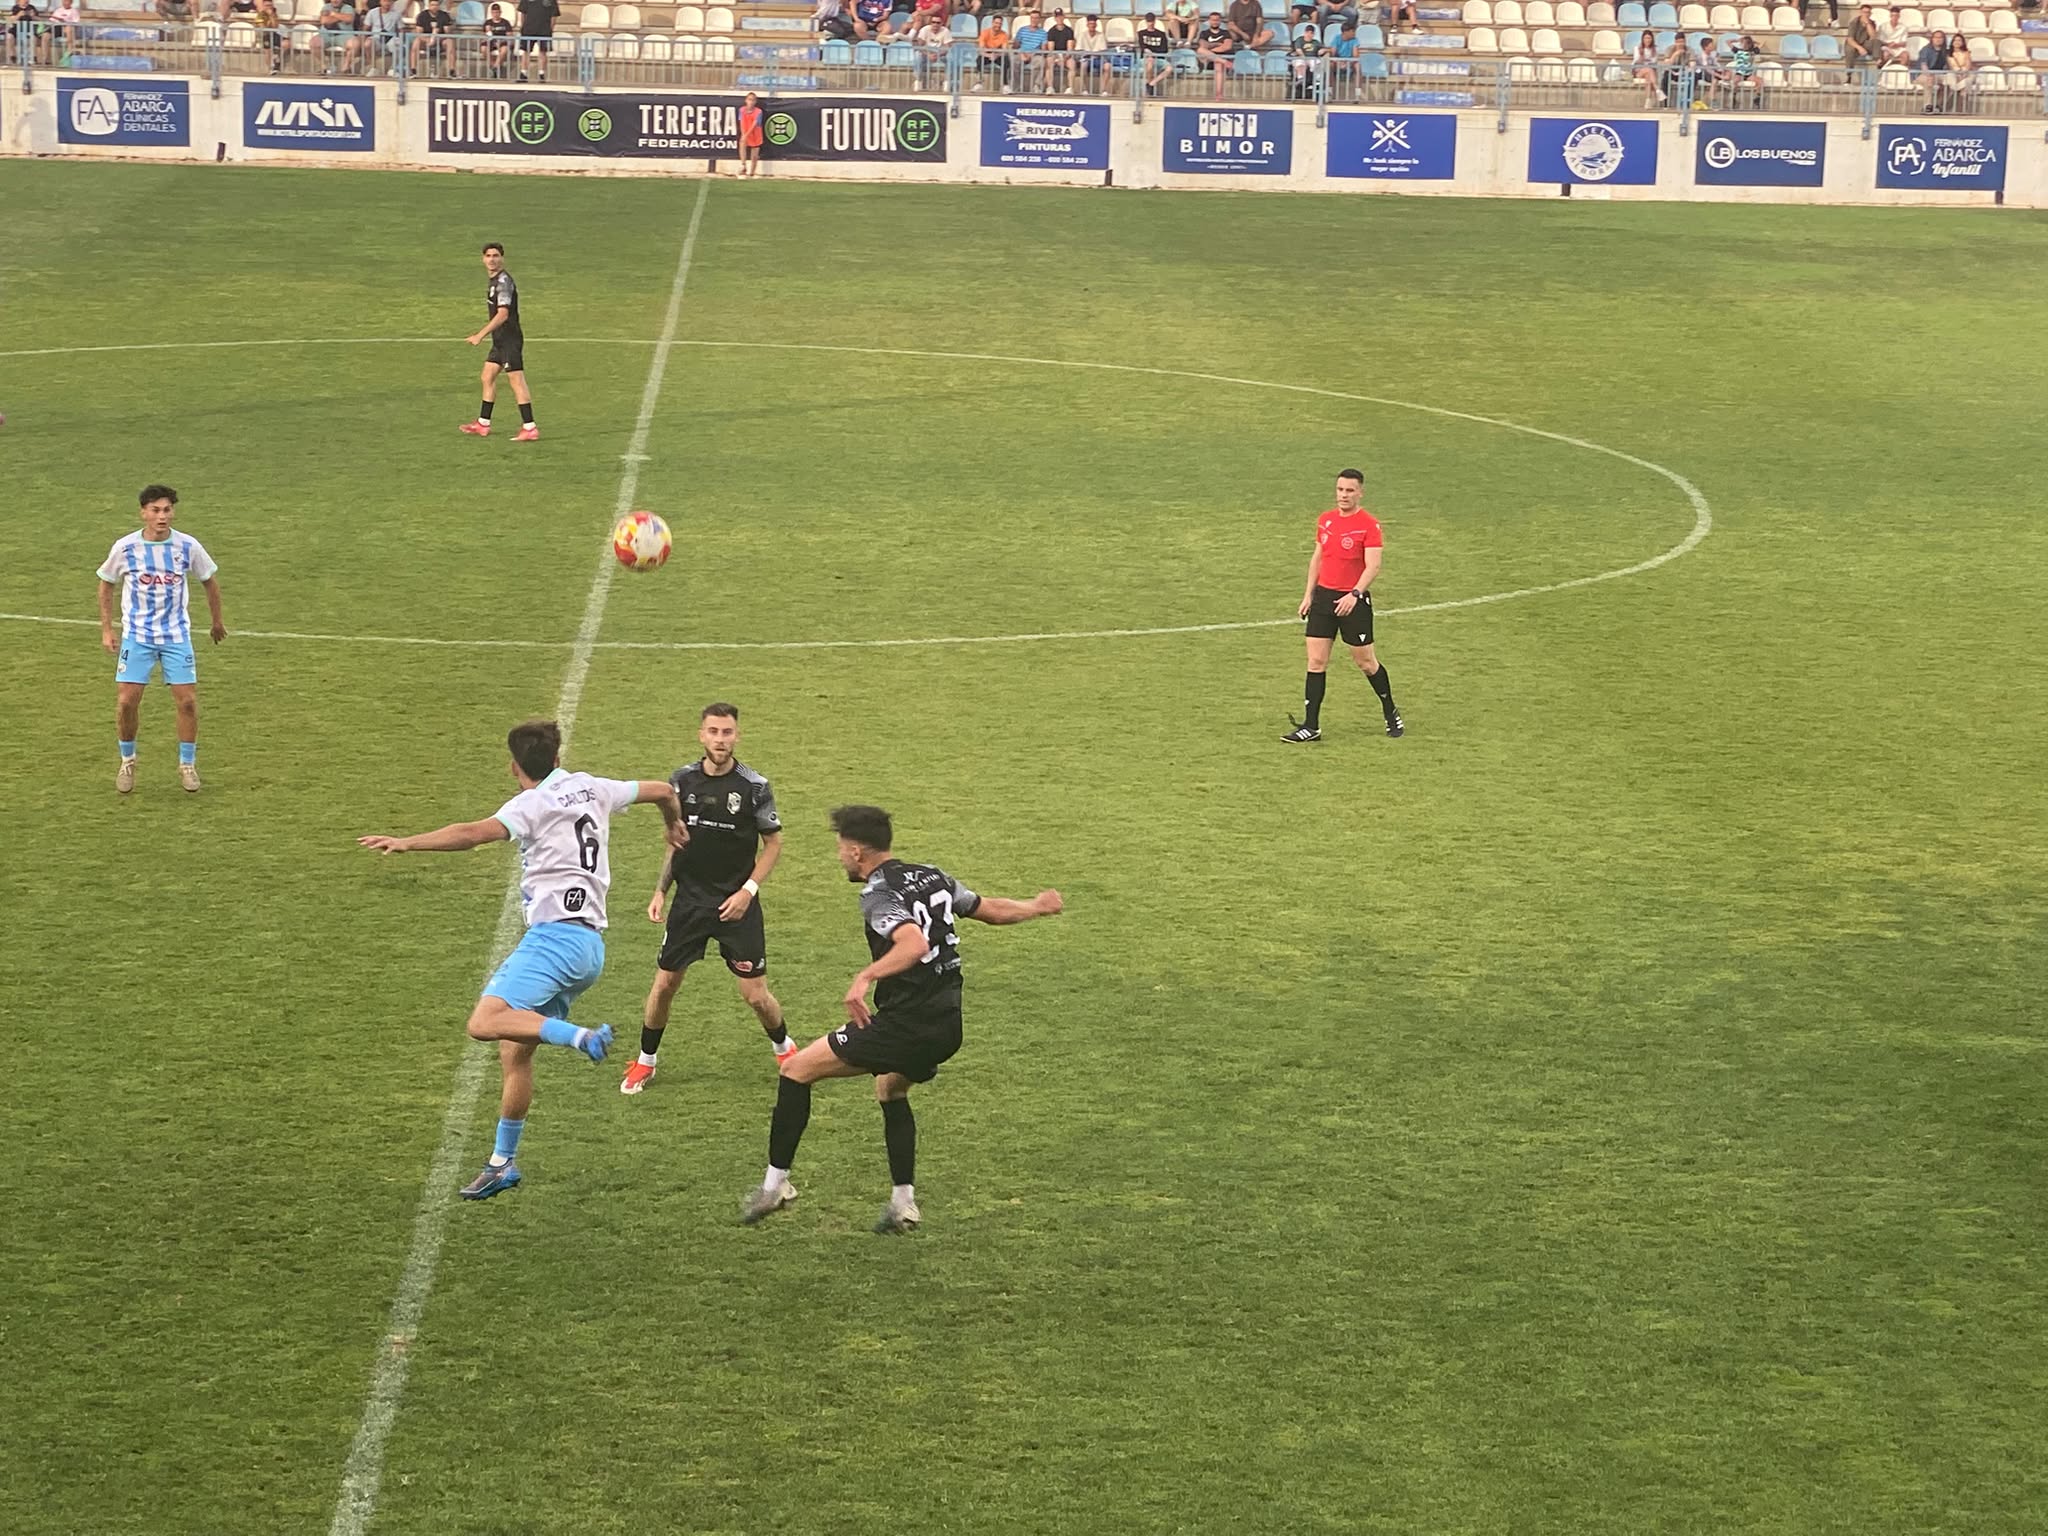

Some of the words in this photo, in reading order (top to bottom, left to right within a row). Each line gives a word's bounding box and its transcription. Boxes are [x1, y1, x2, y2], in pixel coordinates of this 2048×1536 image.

[122, 101, 176, 113] ABARCA
[1016, 108, 1075, 118] HERMANOS
[639, 104, 738, 136] TERCERA
[123, 123, 177, 132] DENTALES
[1026, 127, 1072, 136] RIVERA
[638, 138, 738, 149] FEDERACIÓN
[1018, 143, 1072, 152] PINTURAS
[1180, 139, 1275, 155] BIMOR
[1711, 147, 1731, 159] LB
[1932, 148, 1997, 162] ABARCA
[1931, 162, 1982, 178] Infantil
[574, 813, 599, 874] 6
